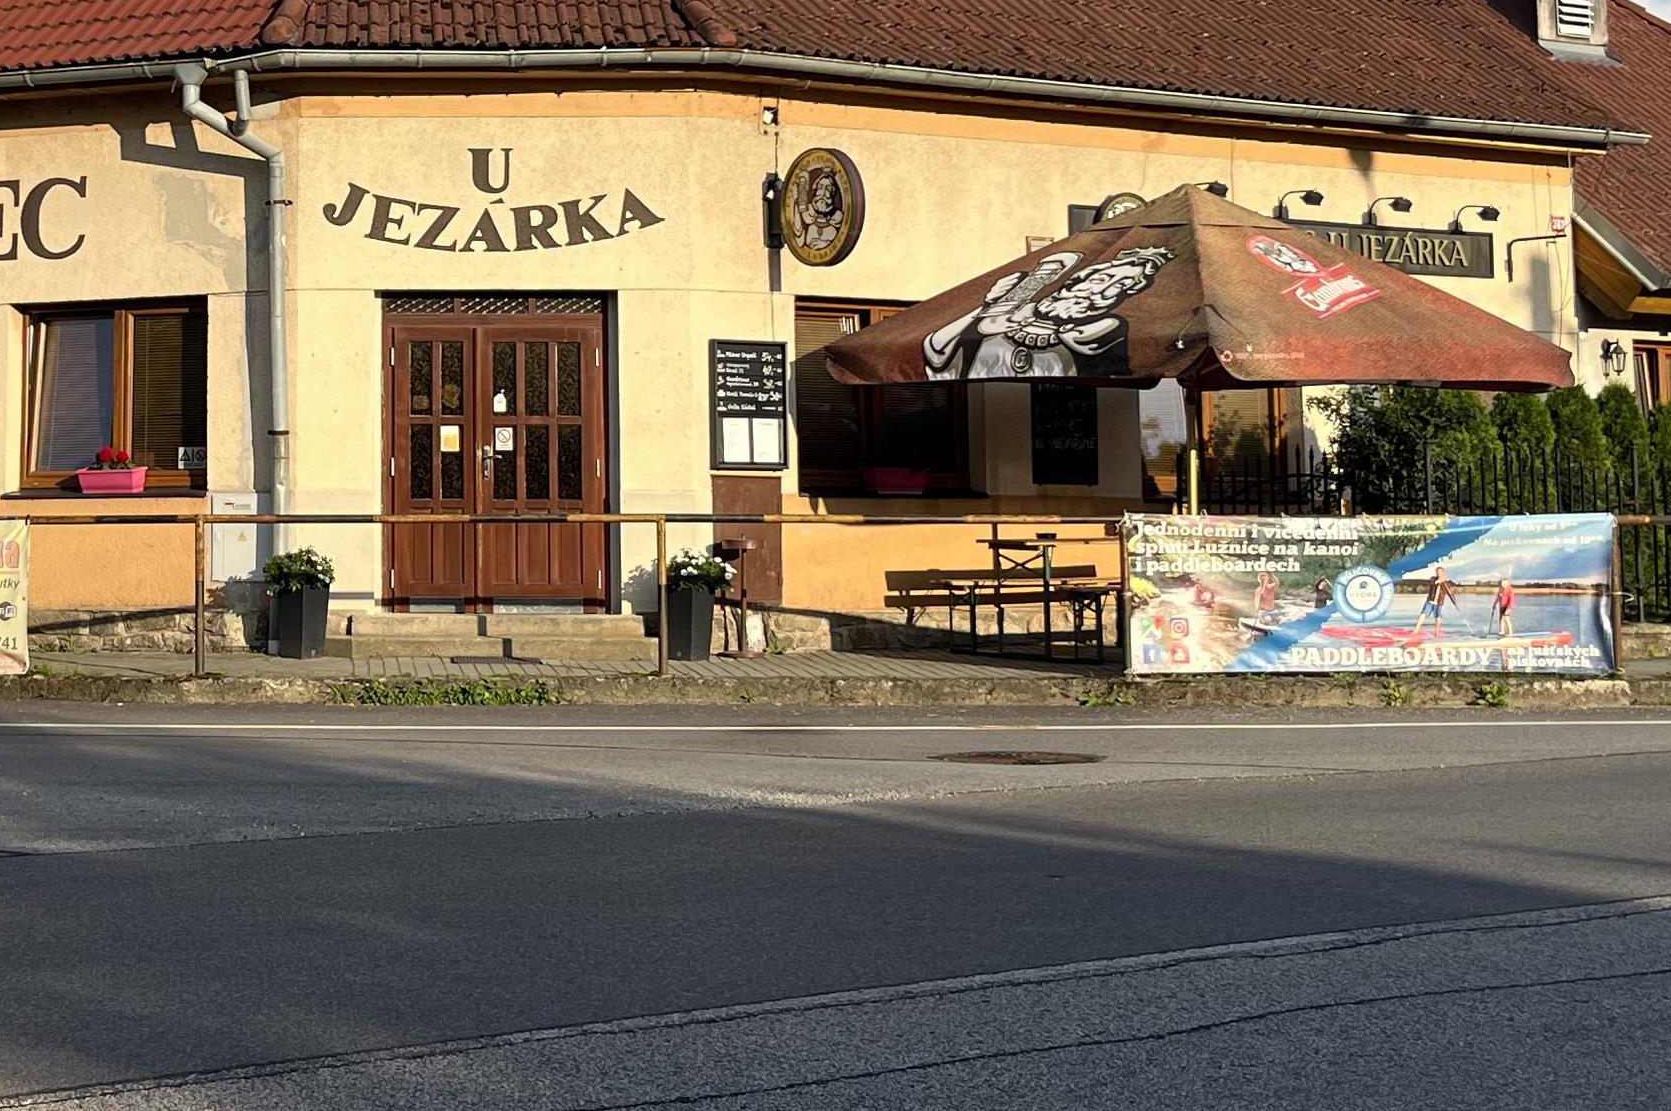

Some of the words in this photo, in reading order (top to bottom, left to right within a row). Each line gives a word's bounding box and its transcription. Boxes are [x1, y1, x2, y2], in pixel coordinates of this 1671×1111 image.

[467, 147, 513, 194] U
[322, 182, 666, 253] JEZÁRKA
[1193, 541, 1269, 556] Lužnice
[1273, 544, 1298, 556] na
[1302, 542, 1359, 557] kanoi
[1146, 557, 1301, 575] paddleboardech
[1290, 645, 1493, 667] PADDLEBOARDY
